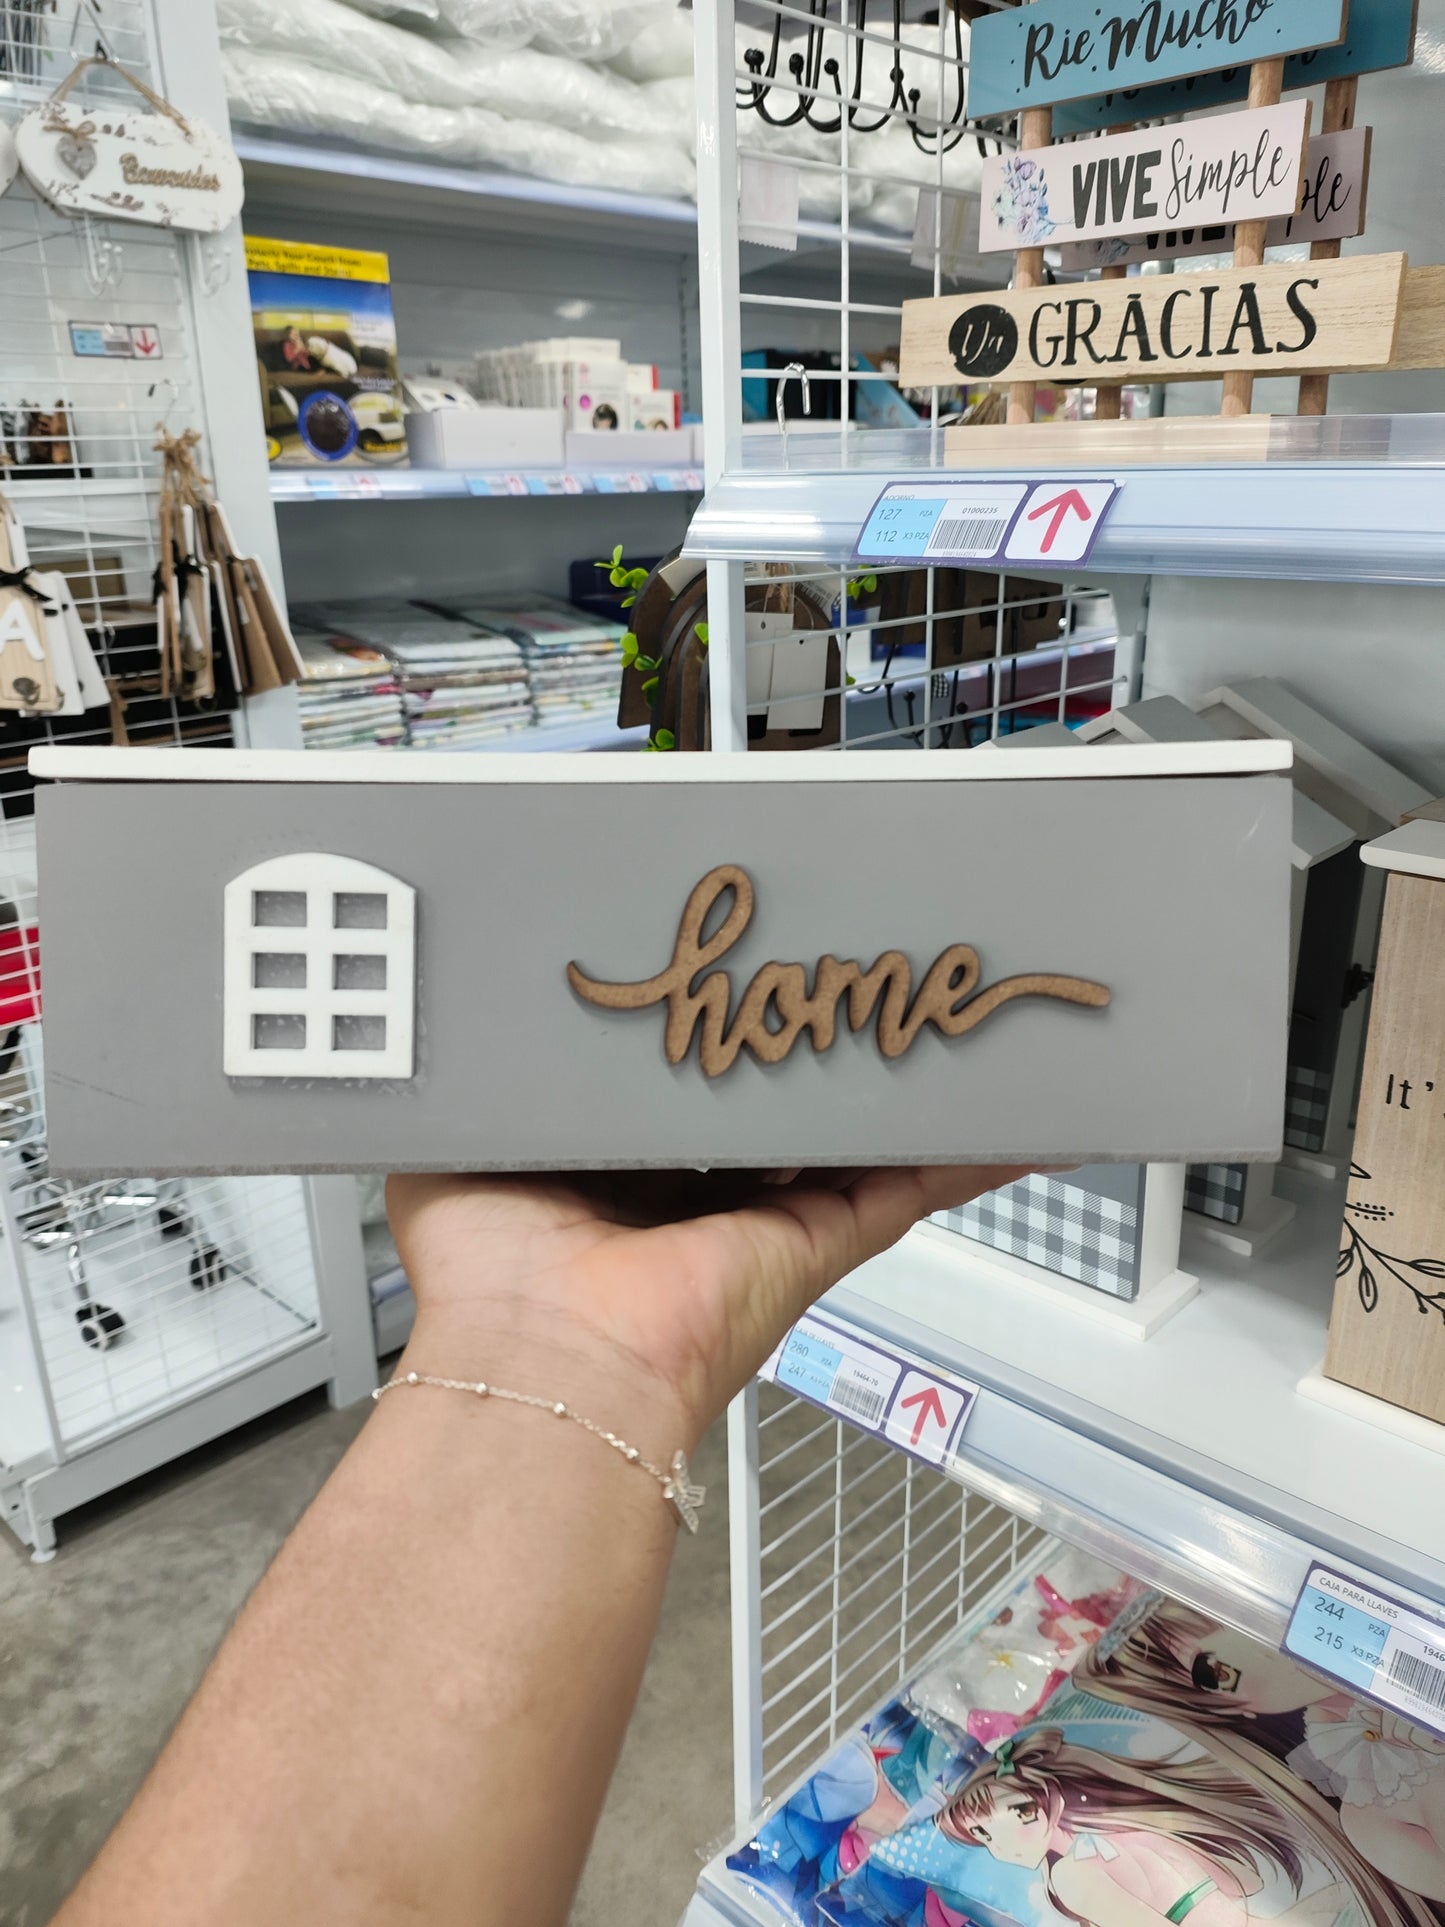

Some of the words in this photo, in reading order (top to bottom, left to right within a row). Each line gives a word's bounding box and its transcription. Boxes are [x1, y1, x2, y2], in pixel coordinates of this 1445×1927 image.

[1024, 22, 1095, 88] Rie
[1101, 0, 1274, 71] Mucho
[1073, 149, 1162, 229] VIVE
[1165, 128, 1293, 215] Simple
[1028, 278, 1319, 368] GRACIAS
[879, 508, 903, 521] 127
[919, 510, 933, 518] PZA
[961, 507, 999, 515] 01000235
[876, 530, 898, 543] 112
[566, 864, 1112, 1078] home
[788, 1362, 807, 1378] 247
[789, 1340, 809, 1358] 280
[1314, 1596, 1345, 1621] 244
[1368, 1623, 1386, 1638] PZA
[1319, 1577, 1341, 1593] CAJA
[1342, 1587, 1365, 1605] PARA
[1366, 1596, 1399, 1619] LLAVES
[1313, 1626, 1344, 1650] 215
[1351, 1645, 1365, 1658] X3
[1365, 1653, 1386, 1668] PZA
